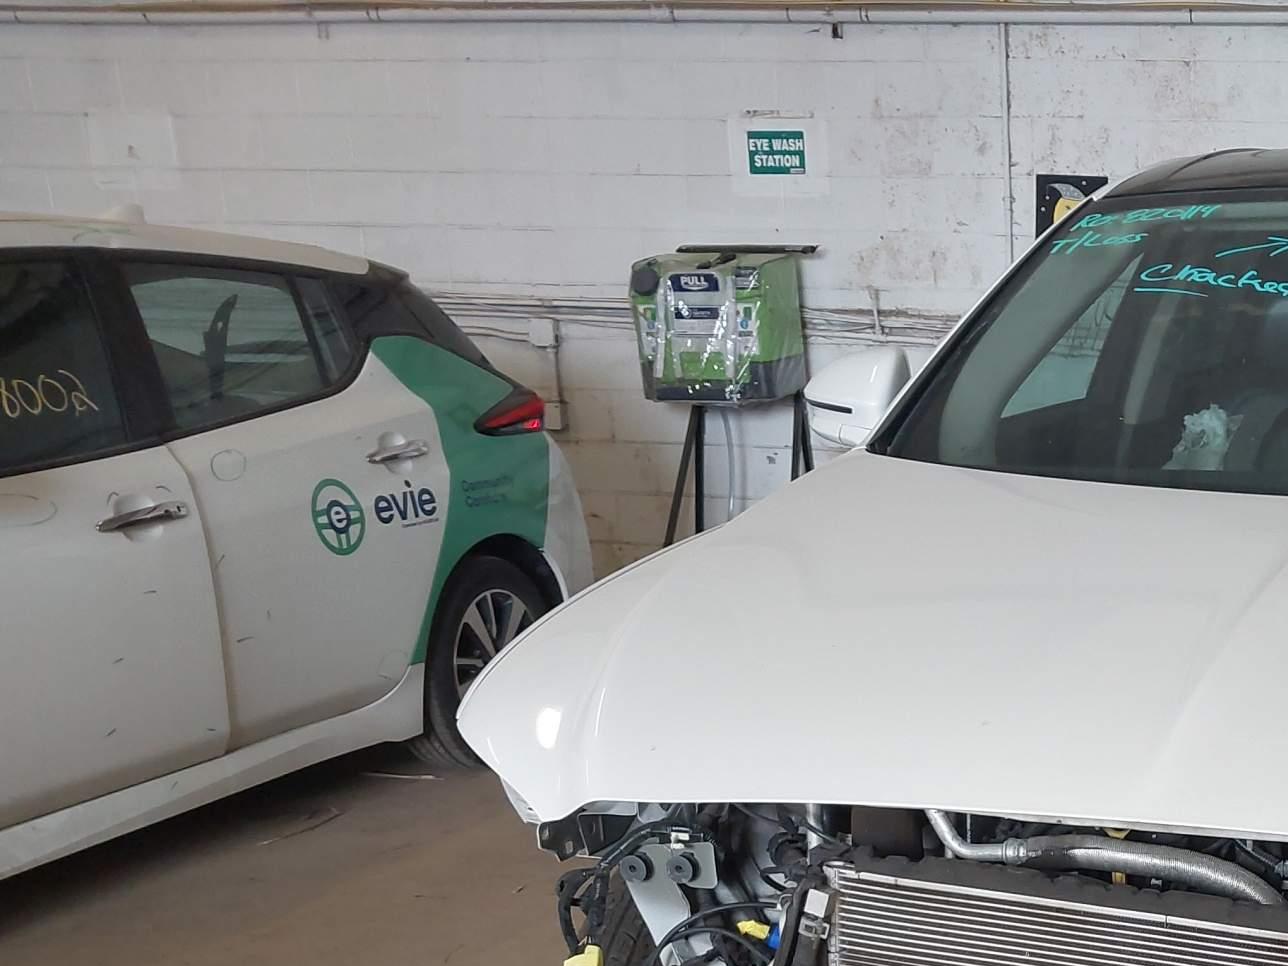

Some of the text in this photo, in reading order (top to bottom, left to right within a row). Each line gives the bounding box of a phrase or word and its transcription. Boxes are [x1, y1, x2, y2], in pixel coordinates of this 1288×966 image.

[749, 138, 804, 151] EYE WASH
[754, 154, 800, 167] STATION
[680, 276, 708, 287] PULL
[374, 480, 437, 525] evie
